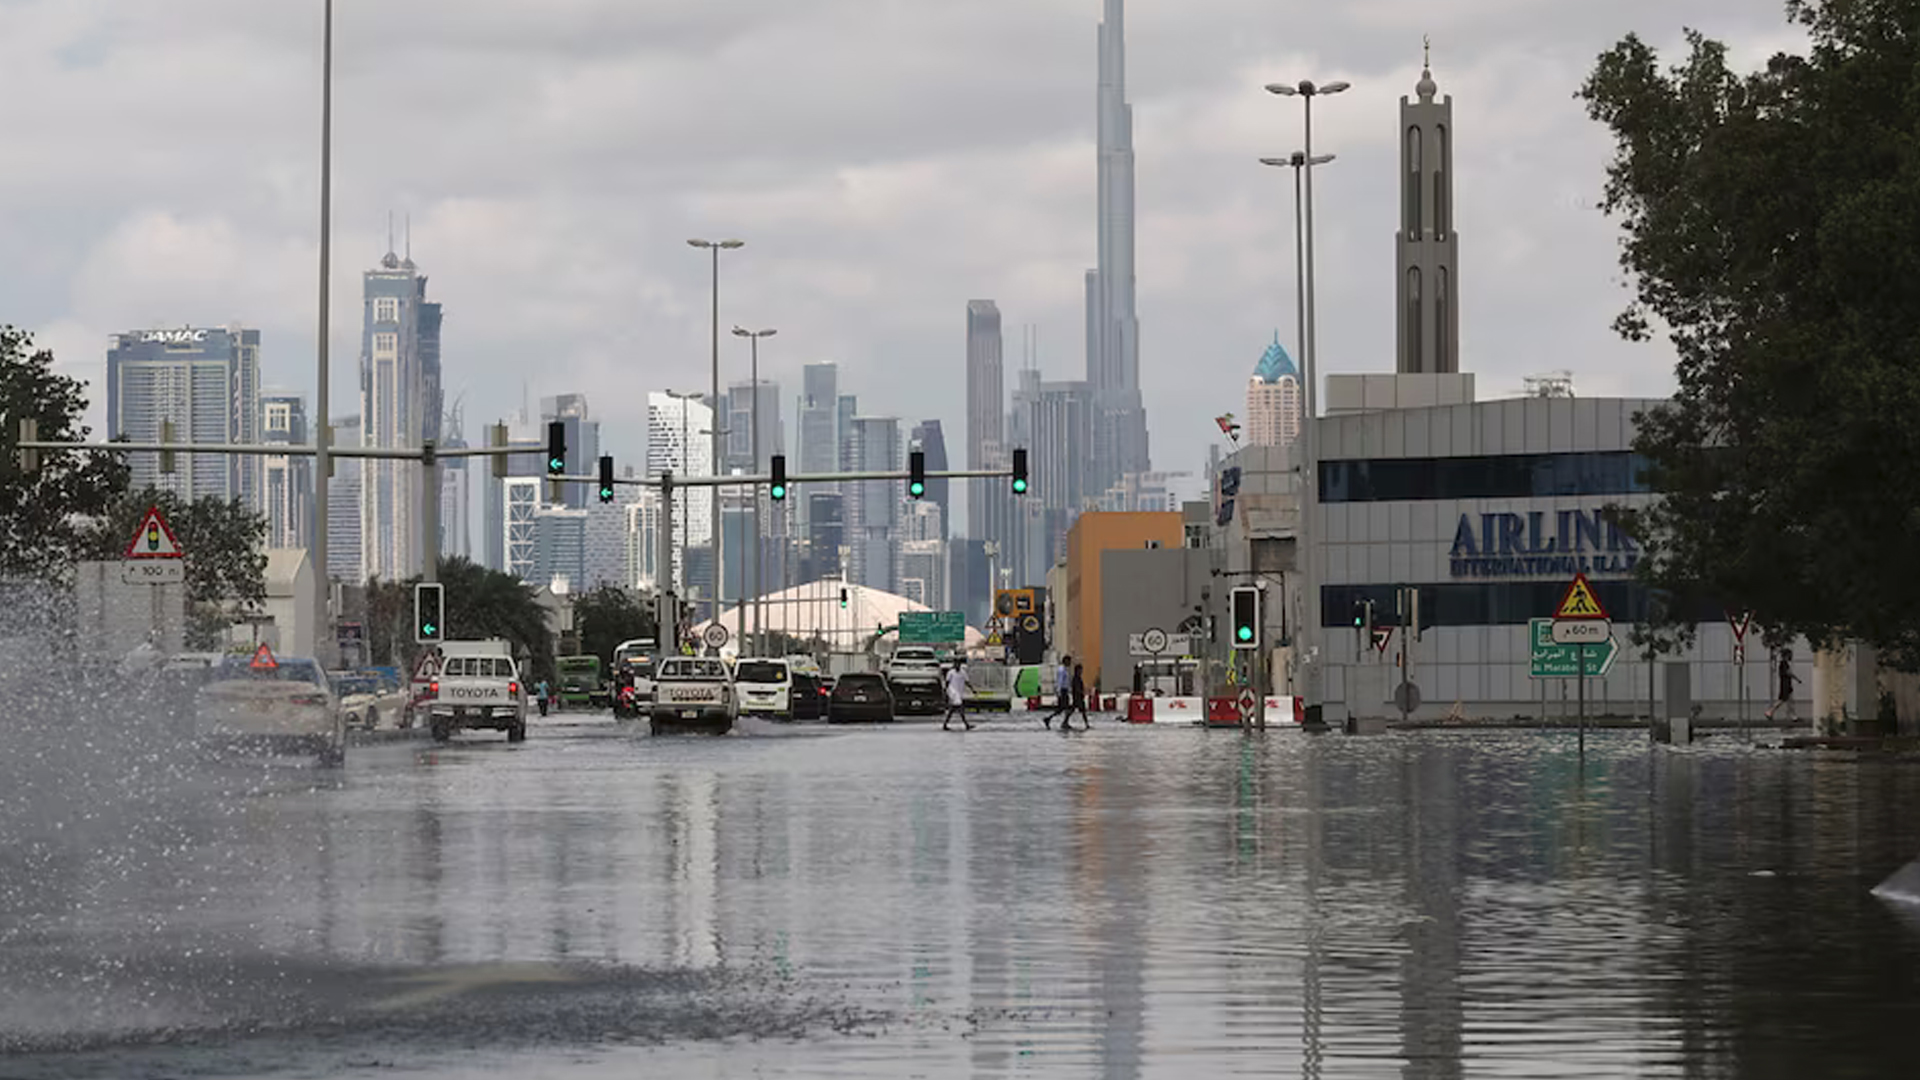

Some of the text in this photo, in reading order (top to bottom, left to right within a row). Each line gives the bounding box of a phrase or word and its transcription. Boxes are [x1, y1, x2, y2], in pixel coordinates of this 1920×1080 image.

[1448, 508, 1639, 555] AIRLINK
[1450, 556, 1591, 577] INTERNATIONAL
[708, 630, 724, 641] 60
[1572, 625, 1599, 635] 60 m
[1147, 635, 1163, 646] 60
[450, 688, 499, 698] TOYOTA
[669, 687, 714, 698] TOYOTA
